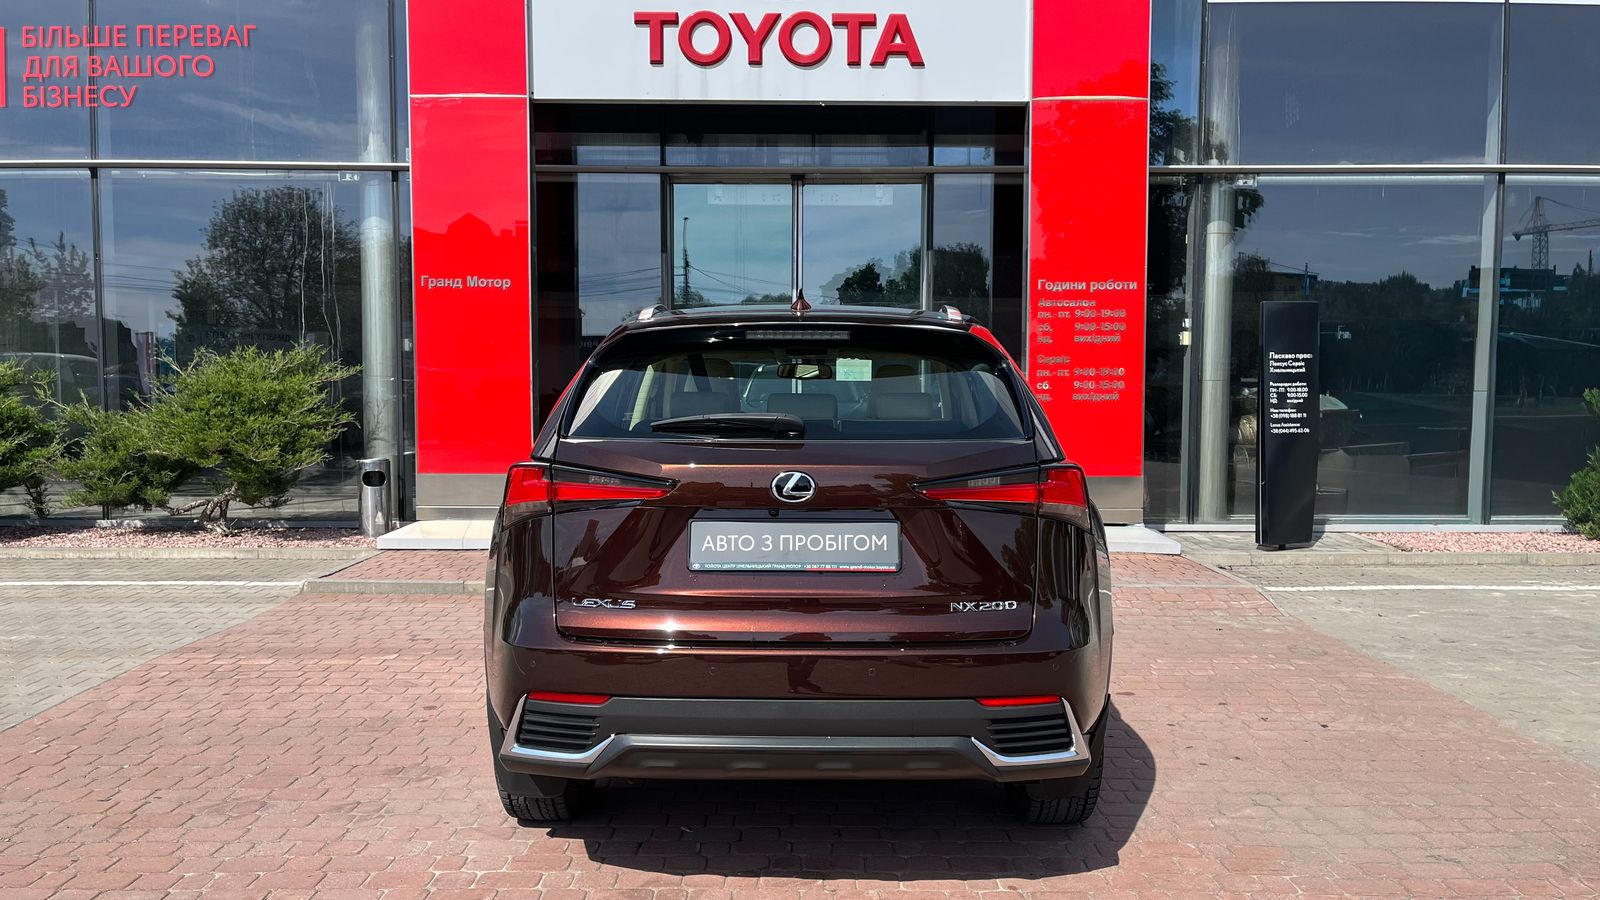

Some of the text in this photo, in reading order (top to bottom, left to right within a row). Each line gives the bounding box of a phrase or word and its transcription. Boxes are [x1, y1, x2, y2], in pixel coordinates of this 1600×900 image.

[22, 24, 257, 47] БІЛЬШЕ ПЕРЕВАГ
[634, 10, 925, 67] TOYOTA
[23, 54, 215, 82] ДЛЯ ВАШОГО
[23, 84, 137, 108] БІЗНЕСУ
[421, 275, 511, 290] Гранд Мотор
[1037, 279, 1137, 292] Години роботи
[1038, 298, 1096, 307] Автосалон
[1269, 351, 1295, 359] Ласкаво
[701, 534, 888, 551] АВТО З ПРОБІГОМ
[572, 597, 636, 609] LEXUS
